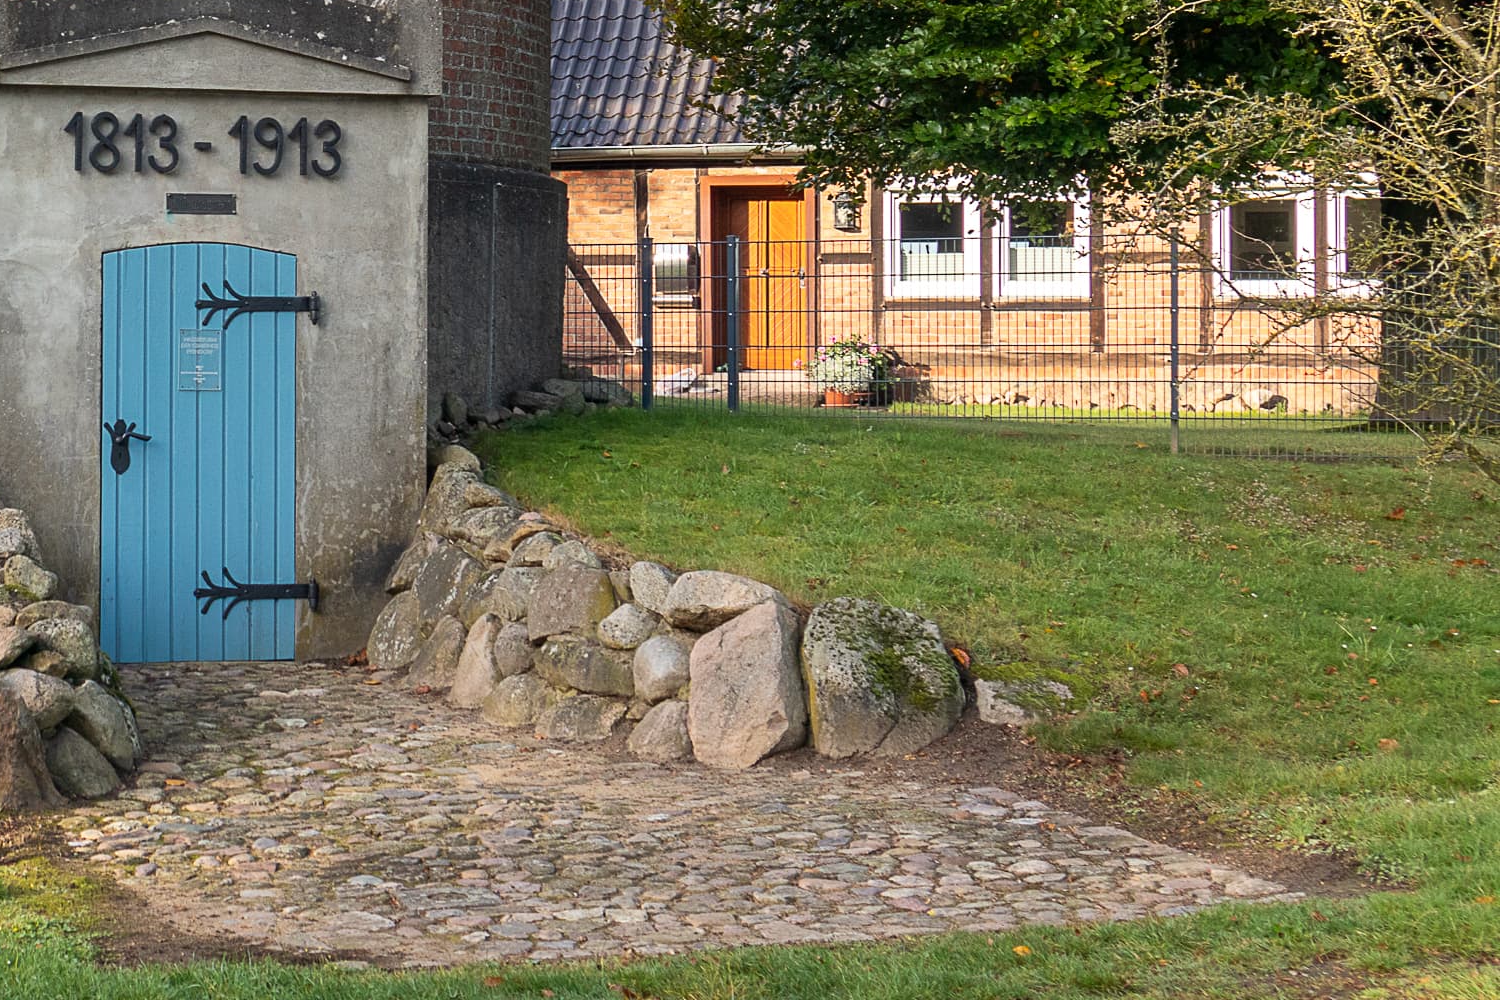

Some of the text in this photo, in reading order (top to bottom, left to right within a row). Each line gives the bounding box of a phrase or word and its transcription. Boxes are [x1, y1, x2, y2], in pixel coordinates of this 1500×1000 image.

[64, 111, 342, 177] 1813 - 1913
